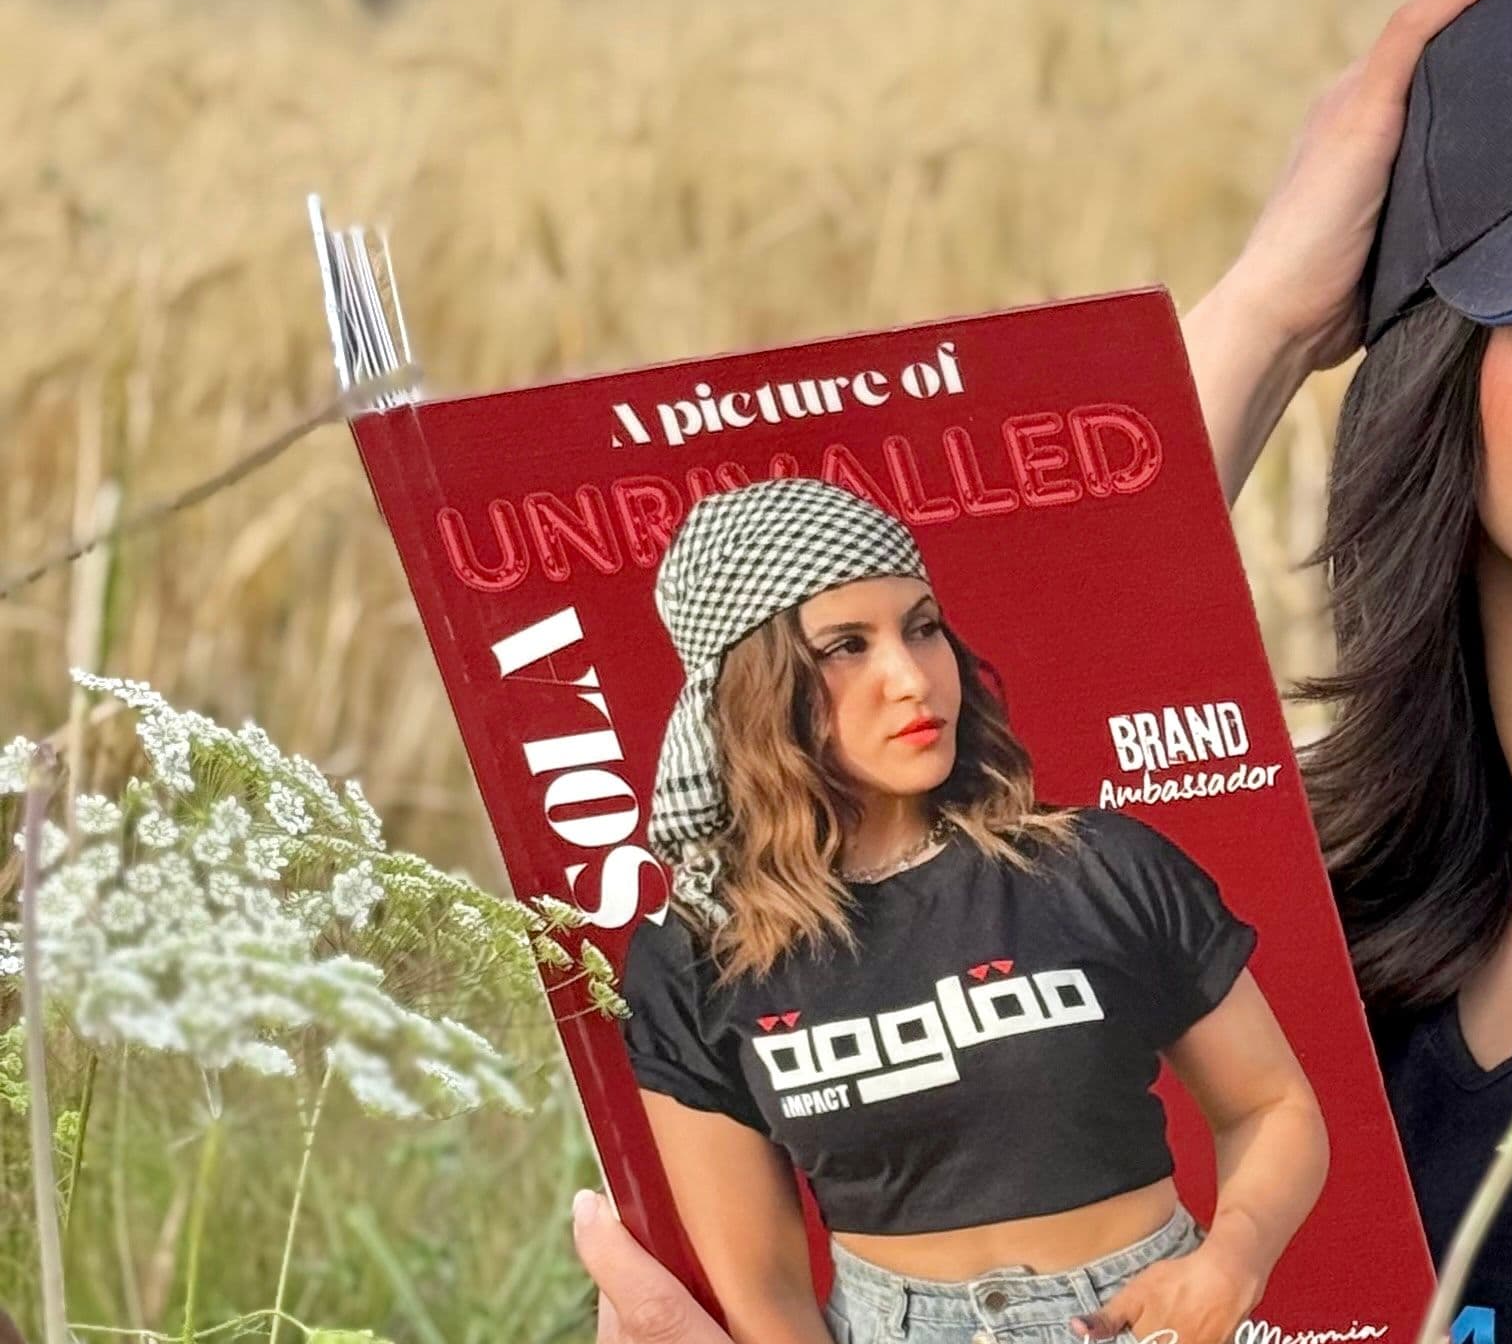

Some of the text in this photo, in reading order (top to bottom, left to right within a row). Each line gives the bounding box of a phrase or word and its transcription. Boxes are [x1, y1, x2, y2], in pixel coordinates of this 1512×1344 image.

[611, 341, 965, 448] A picture of
[436, 402, 1163, 593] UNRALLED
[490, 605, 671, 930] SOLA
[1099, 763, 1282, 810] Ambassador
[1107, 701, 1250, 772] BRAND
